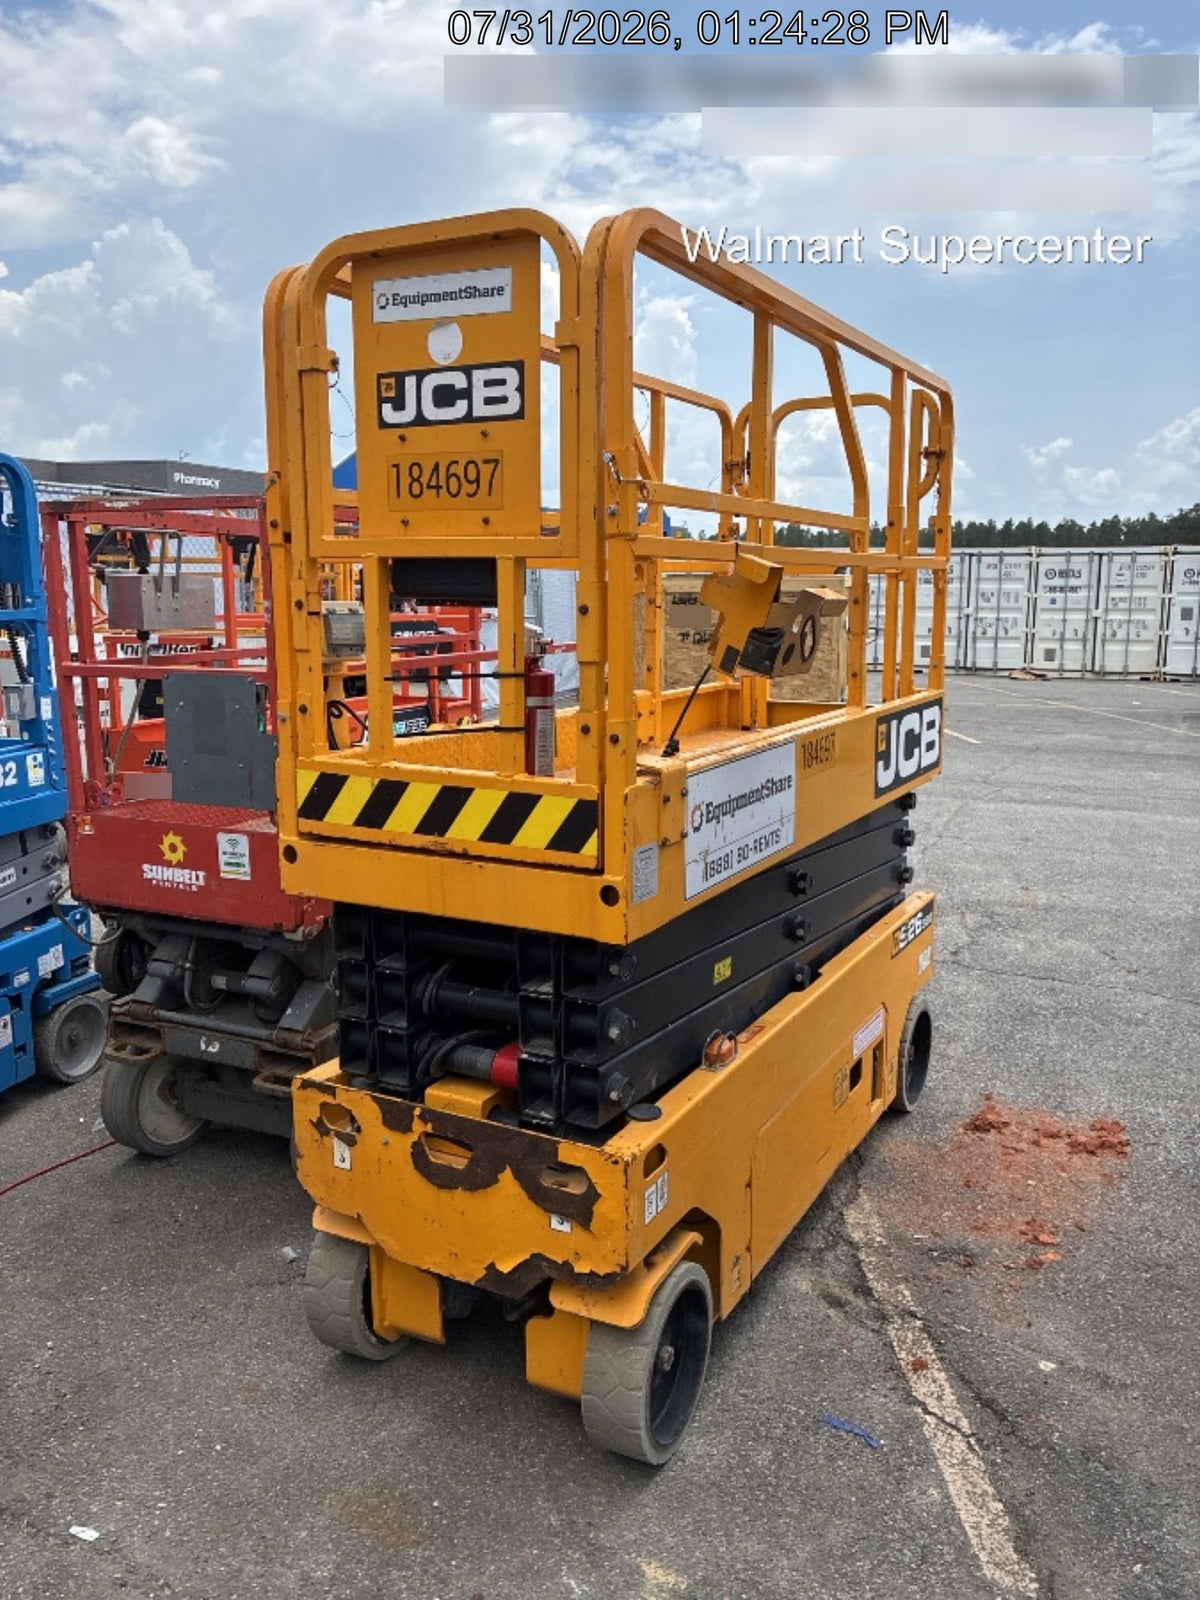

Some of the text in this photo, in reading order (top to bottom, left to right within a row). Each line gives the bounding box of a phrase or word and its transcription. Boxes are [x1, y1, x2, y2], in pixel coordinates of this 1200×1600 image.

[391, 284, 505, 309] EquipmentShare
[381, 366, 523, 424] JCB
[173, 472, 221, 489] Pharmacy
[391, 458, 500, 500] 184697
[876, 705, 941, 789] JCB
[704, 774, 793, 825] EquipmentShare
[142, 863, 207, 886] SUNBELT
